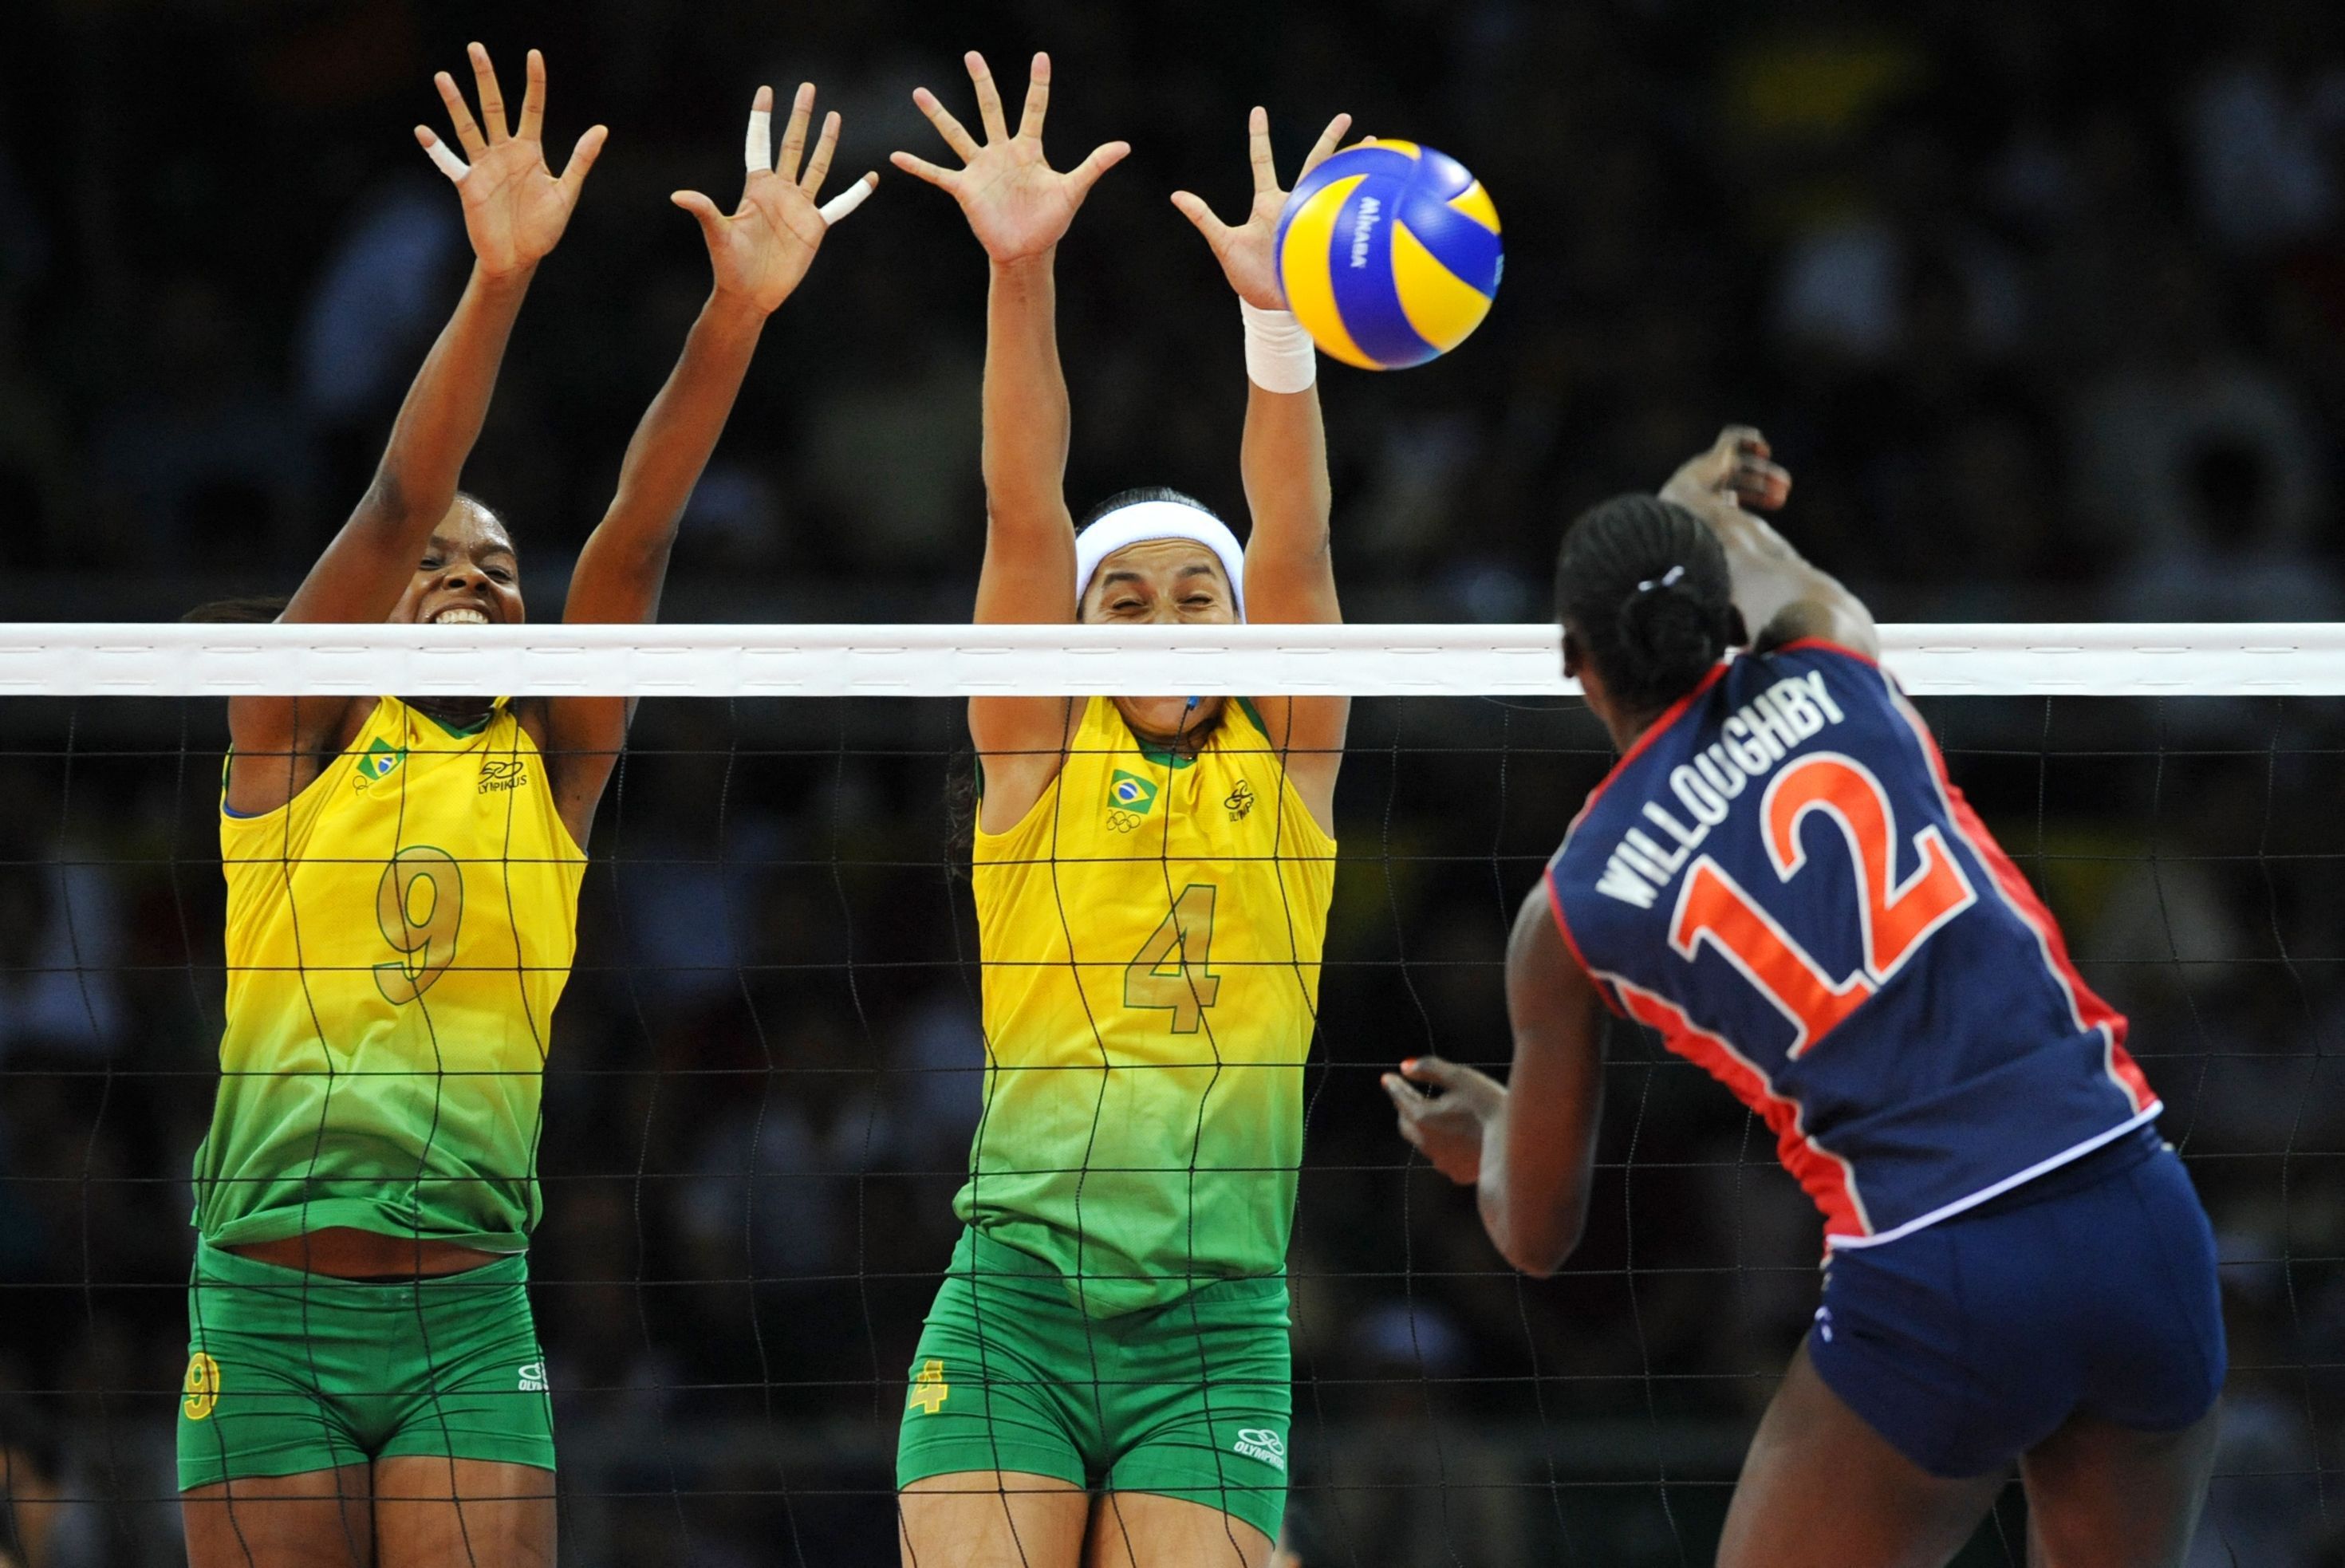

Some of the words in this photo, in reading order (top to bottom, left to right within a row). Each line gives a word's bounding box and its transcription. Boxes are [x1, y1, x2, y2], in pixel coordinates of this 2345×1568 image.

[478, 774, 527, 794] LYMPIKUS
[1595, 669, 1845, 909] WILLOUGHBY
[372, 845, 463, 1006] 9
[1123, 884, 1221, 1034] 4
[1667, 751, 1978, 1062] 12
[183, 1352, 220, 1420] 9
[909, 1360, 948, 1414] 4
